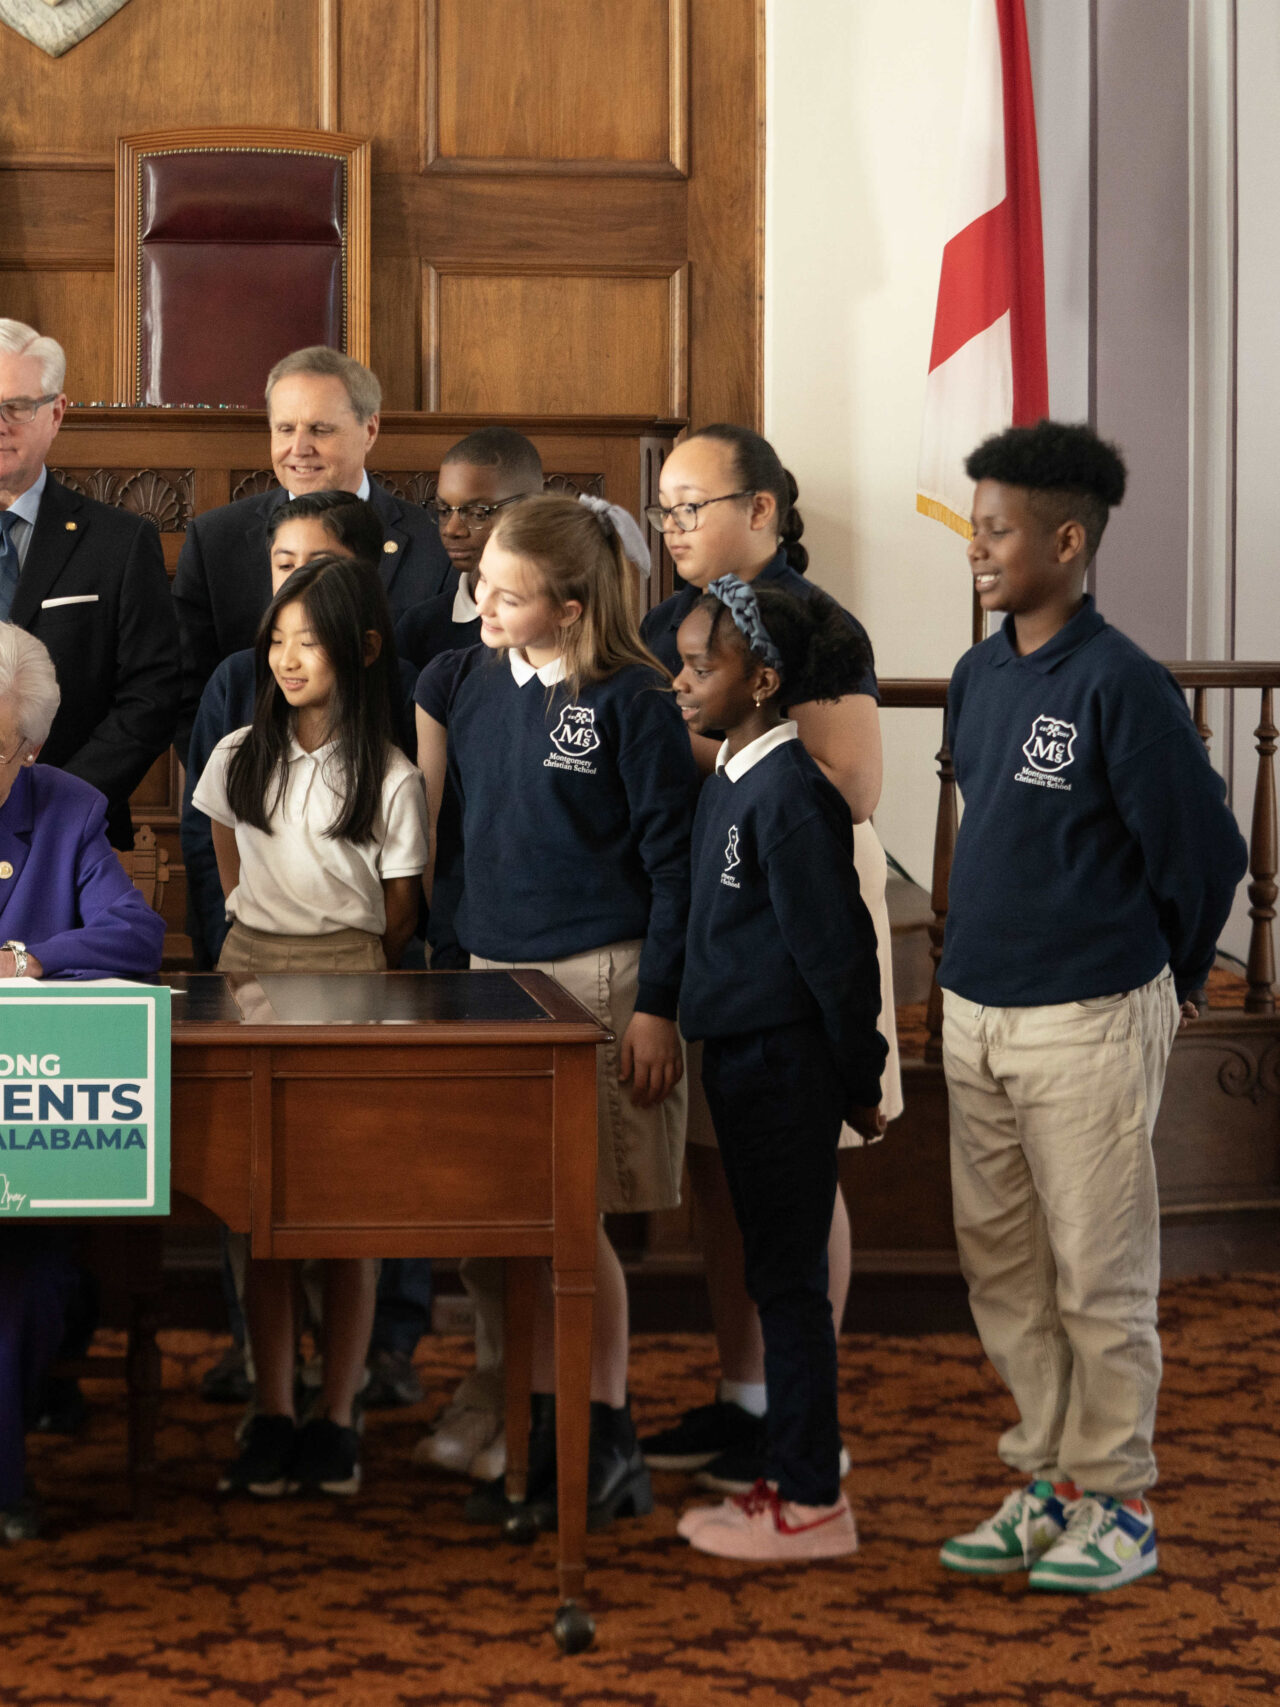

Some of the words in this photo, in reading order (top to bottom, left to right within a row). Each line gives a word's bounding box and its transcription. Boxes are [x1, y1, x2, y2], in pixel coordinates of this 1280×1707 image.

[543, 759, 572, 770] Christian
[573, 765, 597, 774] School
[549, 752, 592, 768] Montgomery
[1014, 773, 1046, 786] Christian
[1047, 781, 1071, 791] School
[1022, 767, 1066, 783] Montgomery
